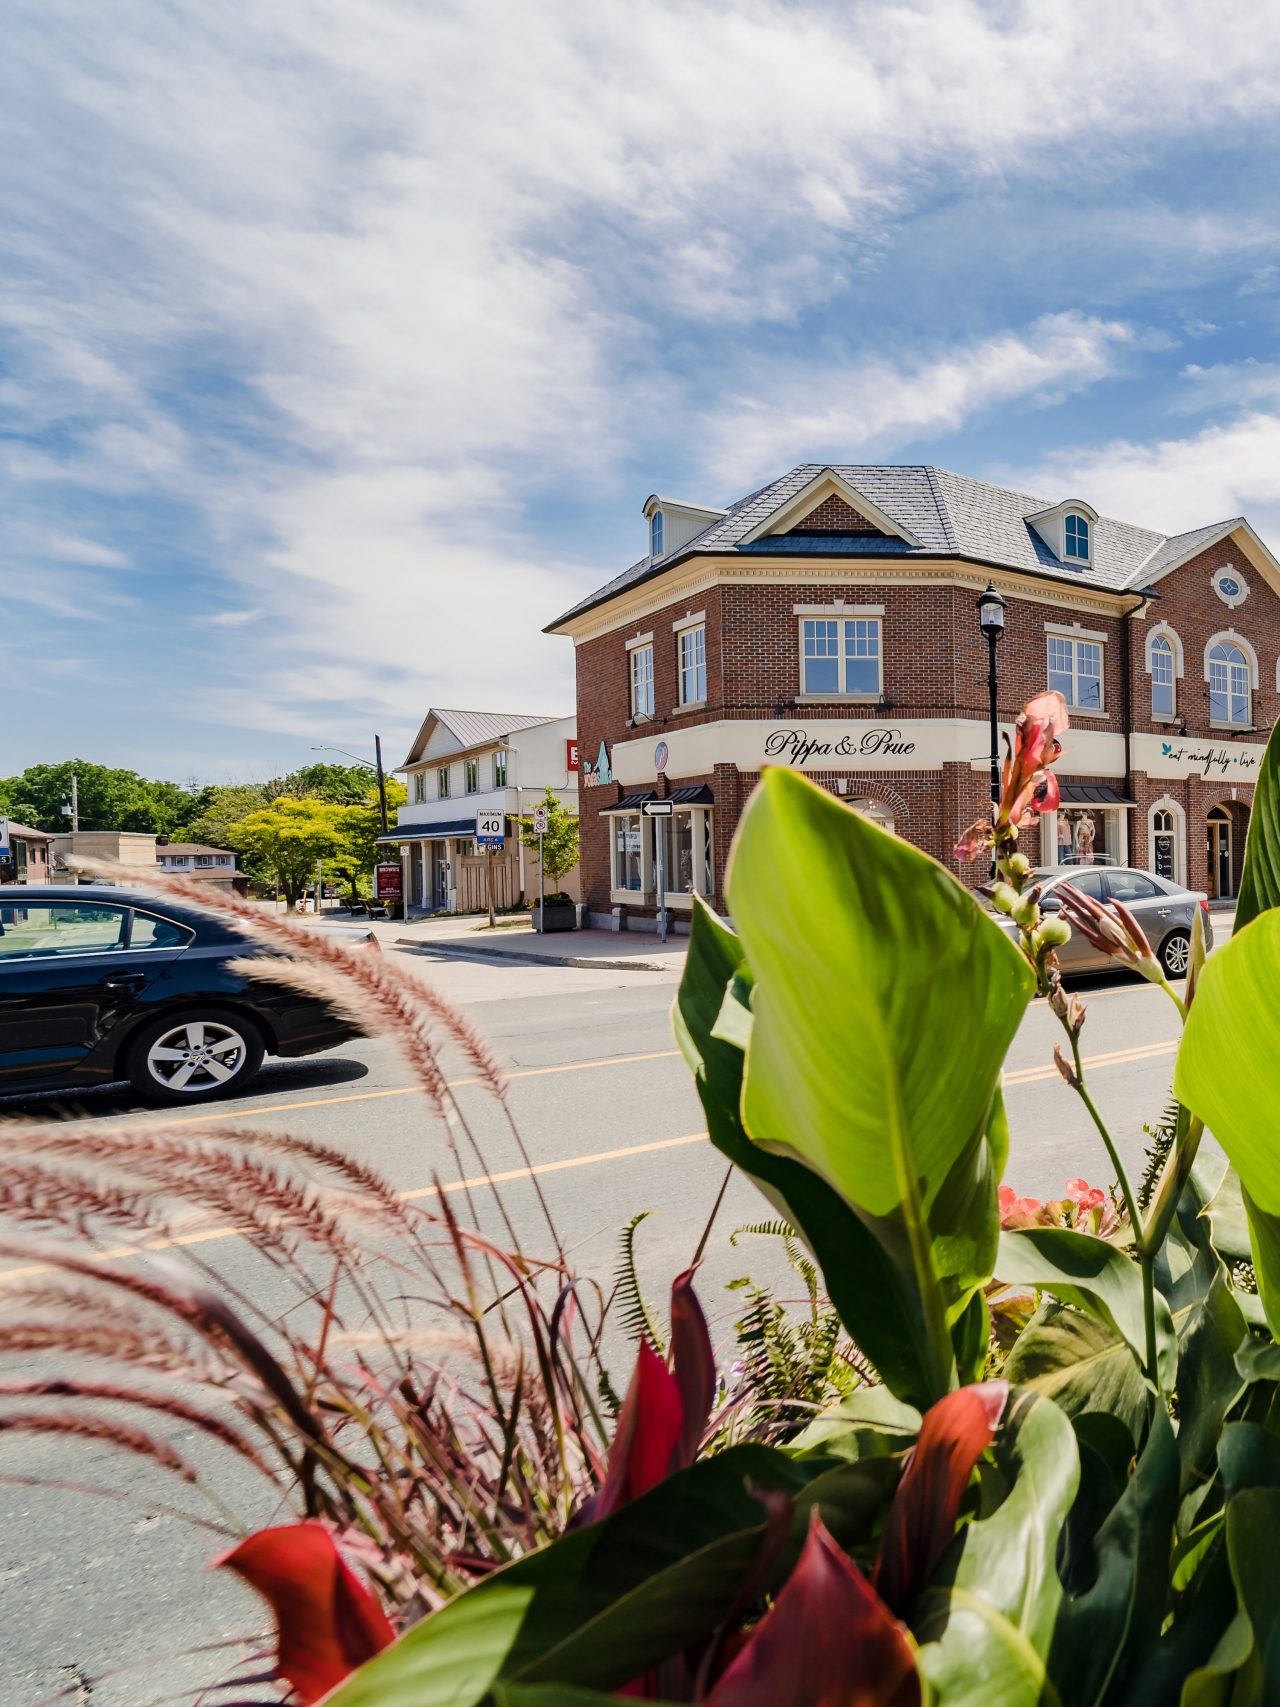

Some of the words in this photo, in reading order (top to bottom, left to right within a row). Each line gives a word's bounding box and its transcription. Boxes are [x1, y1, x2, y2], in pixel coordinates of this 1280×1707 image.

[764, 729, 833, 765] Pippa
[834, 735, 857, 756] &
[859, 728, 916, 756] Prue
[1168, 747, 1188, 762] eat
[1188, 748, 1232, 776] mindfully
[1240, 751, 1257, 768] live
[481, 820, 500, 832] 40
